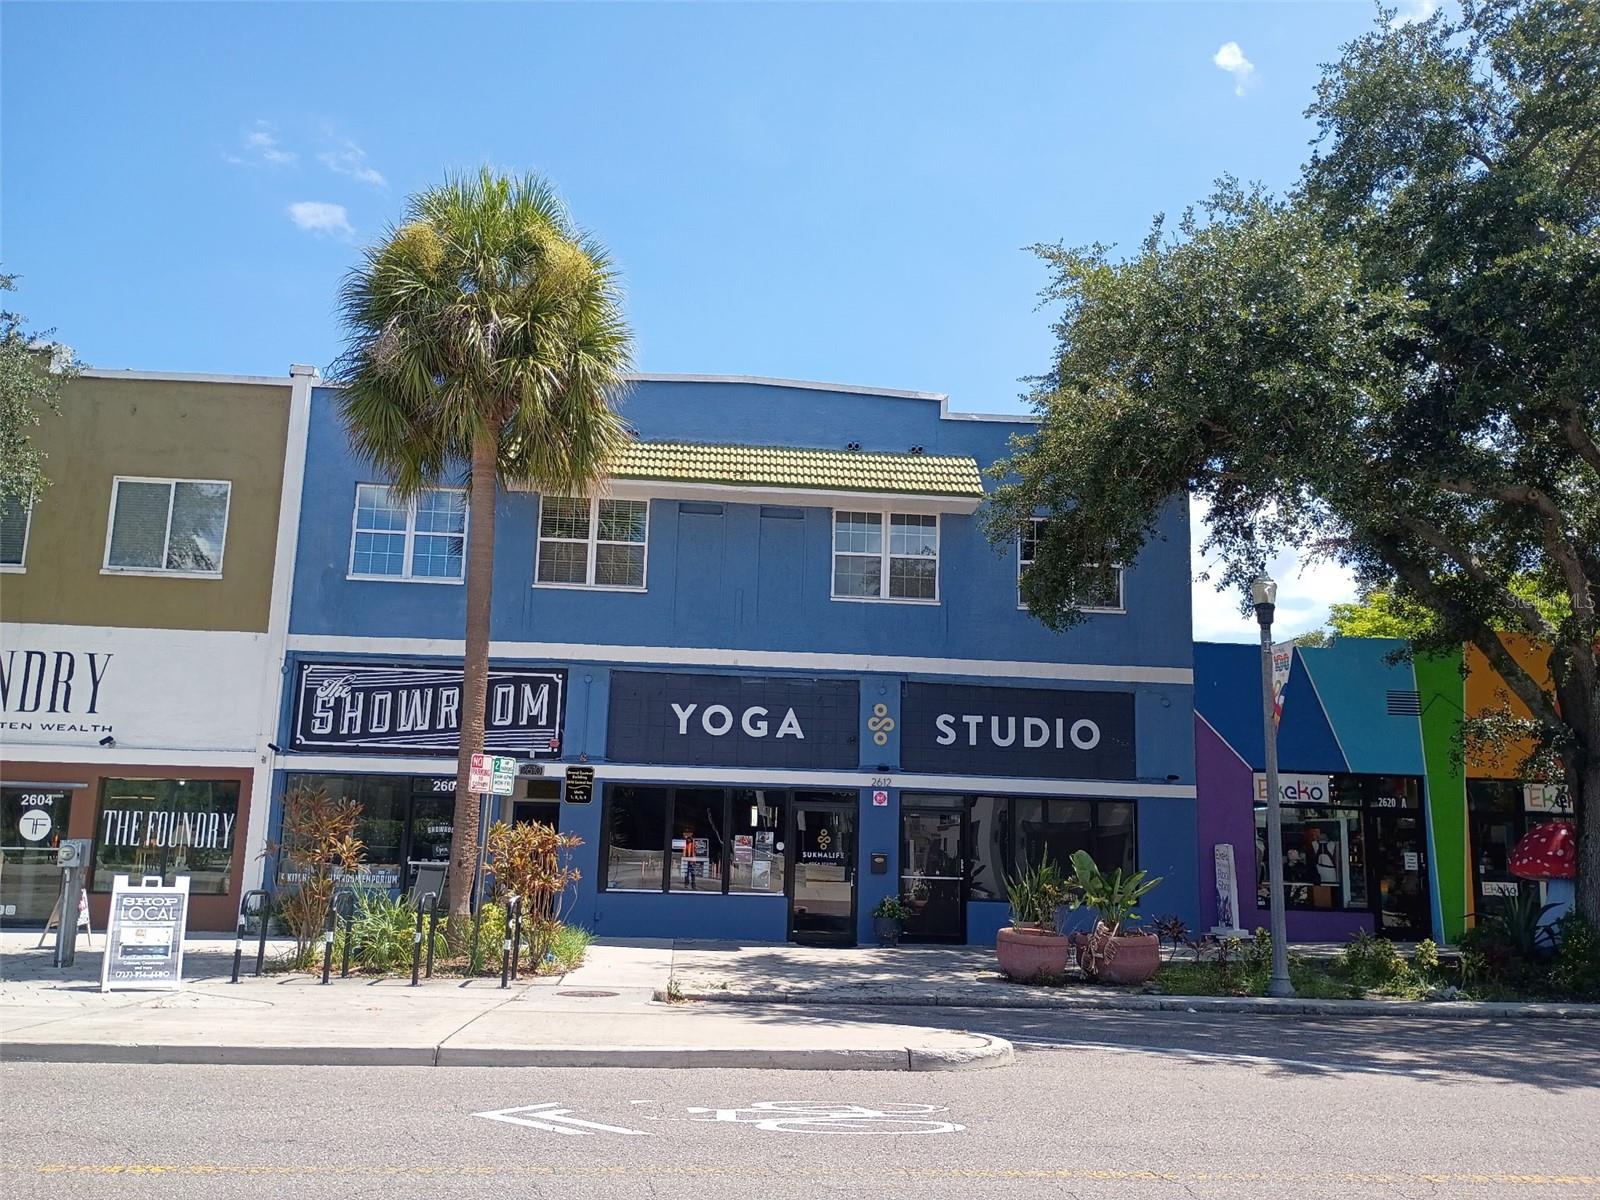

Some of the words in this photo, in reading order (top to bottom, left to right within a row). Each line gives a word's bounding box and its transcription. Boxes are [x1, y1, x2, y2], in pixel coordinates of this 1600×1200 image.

[316, 674, 357, 698] The
[311, 683, 549, 735] SHOWROM
[671, 703, 804, 739] YOGA
[40, 723, 113, 733] WEALTH
[936, 713, 1101, 750] STUDIO
[473, 756, 483, 767] NO
[495, 760, 500, 769] 2
[433, 780, 457, 792] 260
[872, 777, 892, 787] 2612
[20, 794, 54, 806] 2604
[1378, 797, 1396, 808] 2620
[1401, 798, 1407, 808] A
[1530, 787, 1573, 809] Eke
[104, 809, 143, 846] THE
[145, 811, 235, 849] FOUNDRY
[428, 825, 453, 834] SHOWRO
[802, 851, 845, 859] SUKHALIFE
[362, 873, 398, 884] EMPORIUM
[122, 897, 178, 906] SHOP
[120, 906, 177, 920] LOCAL
